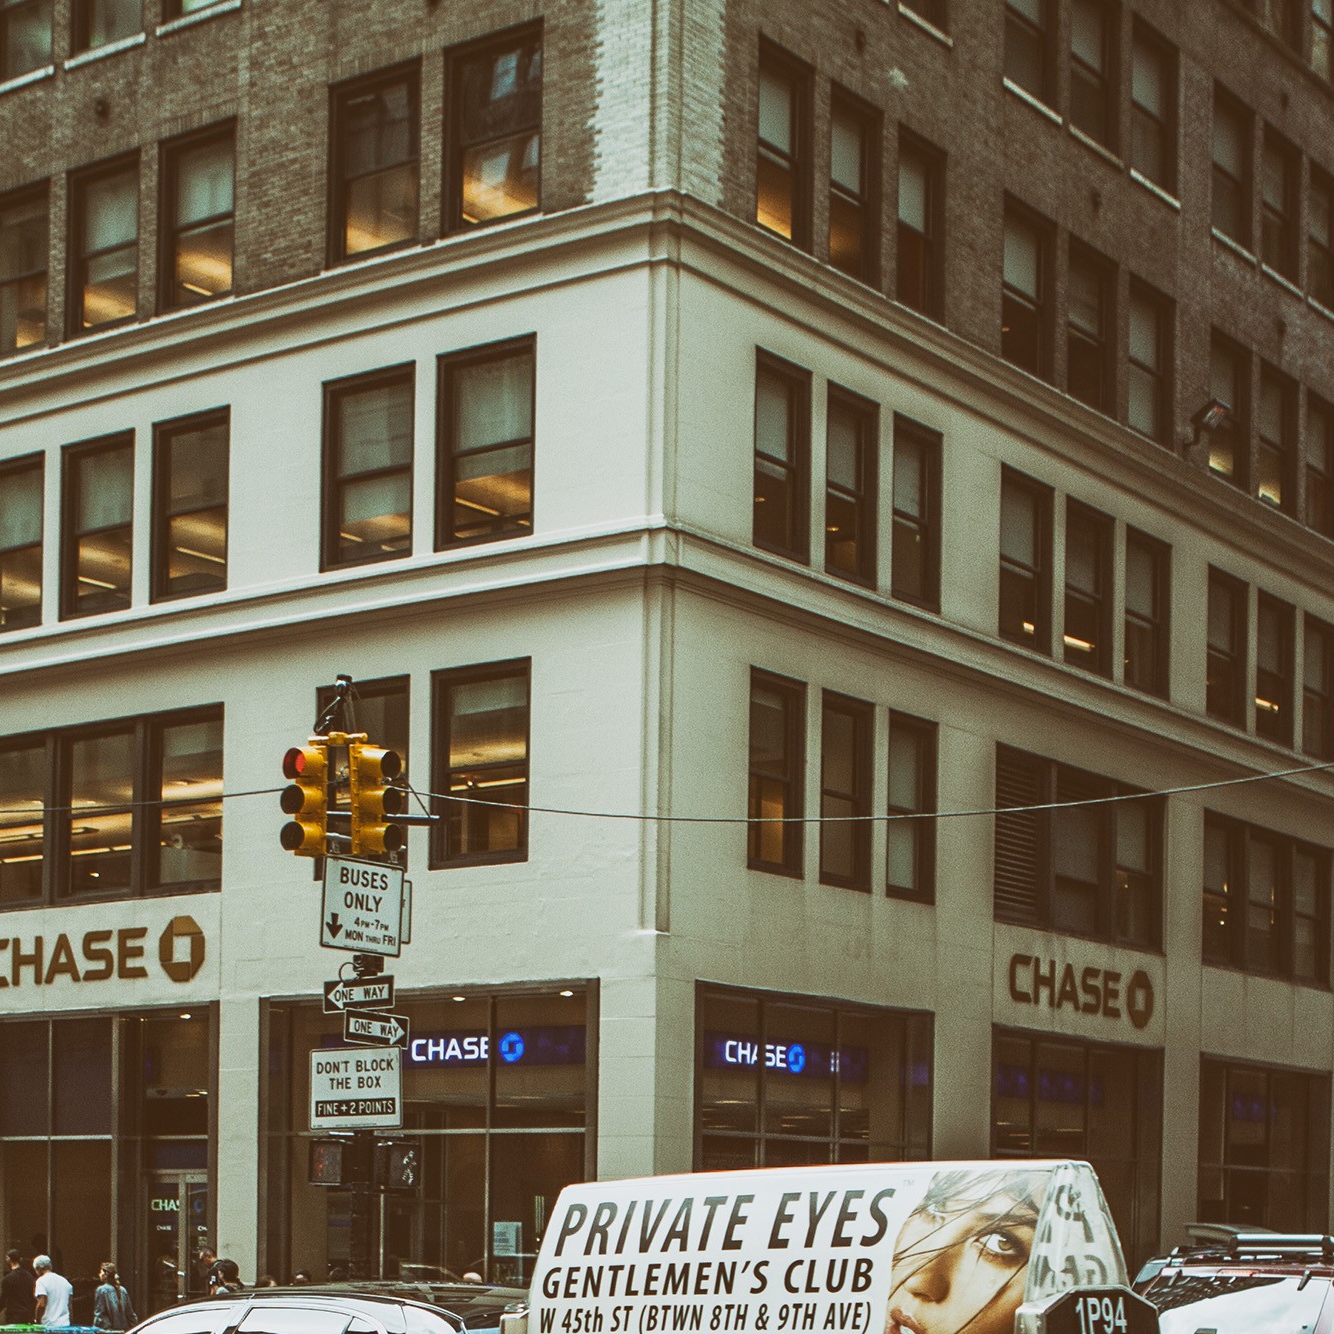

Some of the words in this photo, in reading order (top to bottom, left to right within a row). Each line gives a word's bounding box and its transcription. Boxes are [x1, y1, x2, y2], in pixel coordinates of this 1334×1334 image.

[340, 866, 388, 891] BUSES
[344, 891, 382, 913] ONLY
[345, 929, 364, 942] MON
[365, 935, 381, 945] THRU
[382, 934, 397, 947] FRI
[334, 988, 354, 1003] ONE
[363, 986, 385, 999] WAY
[1008, 953, 1123, 1019] CHASE
[354, 1020, 372, 1034] ONE
[380, 1025, 399, 1038] WAY
[411, 1036, 489, 1062] CHASE
[316, 1060, 350, 1074] DON'T
[355, 1058, 394, 1072] BLOCK
[329, 1078, 351, 1090] THE
[358, 1076, 382, 1089] BOX
[318, 1102, 338, 1116] FINE
[350, 1101, 356, 1114] 2
[359, 1100, 394, 1114] POINTS
[553, 1194, 755, 1257] PRIVATE
[767, 1187, 897, 1250] EYES
[542, 1260, 769, 1299] GENTLEMEN'S
[783, 1257, 874, 1294] CLUB
[539, 1307, 556, 1333] W
[561, 1306, 603, 1334] 45th
[610, 1305, 634, 1332] ST
[638, 1303, 703, 1334] (BTWN
[709, 1303, 746, 1331] 8TH
[755, 1303, 770, 1331] &
[777, 1302, 814, 1330] 9TH
[823, 1301, 872, 1334] AVE)
